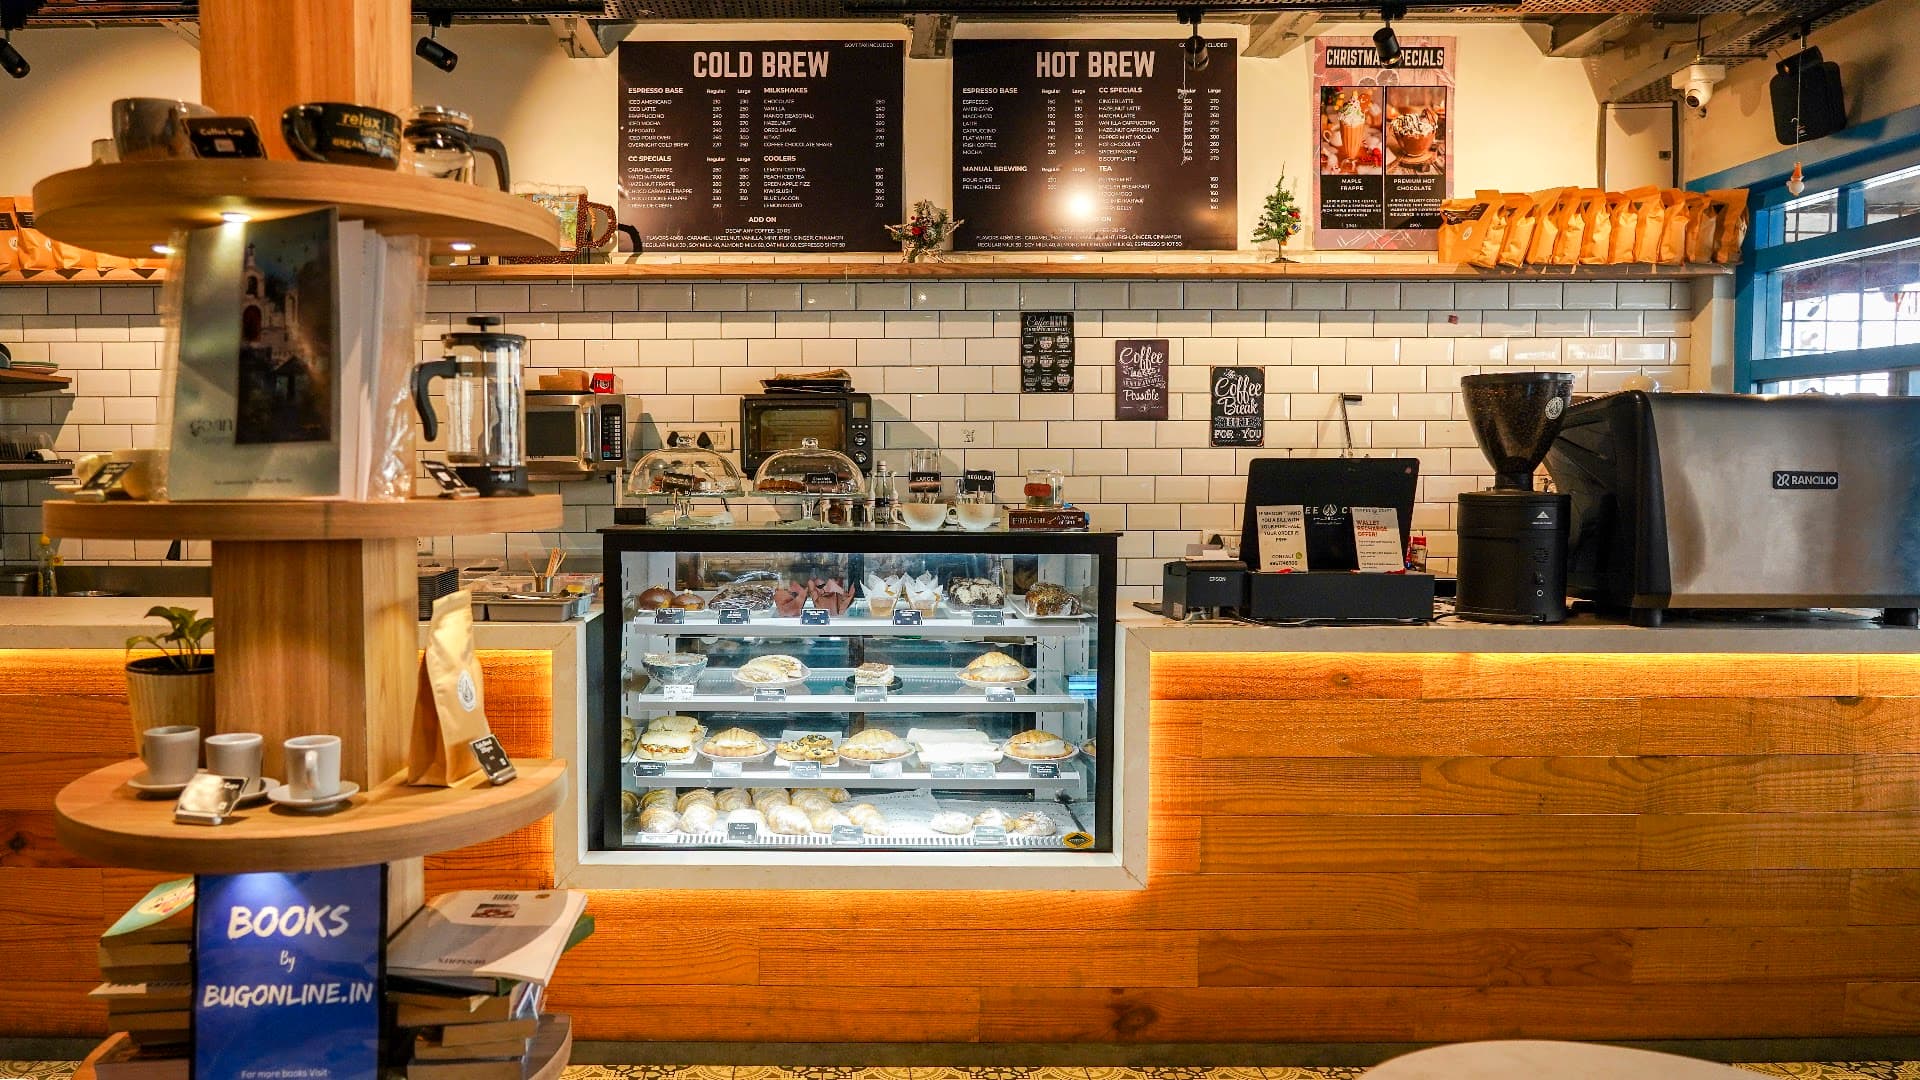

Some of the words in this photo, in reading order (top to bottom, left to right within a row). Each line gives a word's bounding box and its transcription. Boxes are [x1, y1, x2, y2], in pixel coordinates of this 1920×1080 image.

[693, 51, 753, 78] COLD
[762, 51, 829, 78] BREW
[1036, 51, 1080, 78] HOT
[1088, 51, 1156, 78] BREW
[1326, 49, 1381, 66] CHRISTMA
[342, 112, 380, 129] relax
[1119, 345, 1164, 371] Coffee
[1122, 388, 1160, 402] Possible
[1214, 374, 1263, 405] Coffee
[1216, 396, 1259, 416] Break
[1214, 429, 1235, 440] FOR
[1241, 428, 1262, 439] YOU
[1791, 475, 1837, 485] RANCILIO
[227, 904, 350, 940] BOOKS
[279, 949, 296, 973] By
[203, 982, 373, 1008] BUGONLINE.IN
[241, 1070, 257, 1079] For
[257, 1071, 281, 1079] more
[281, 1069, 308, 1078] books
